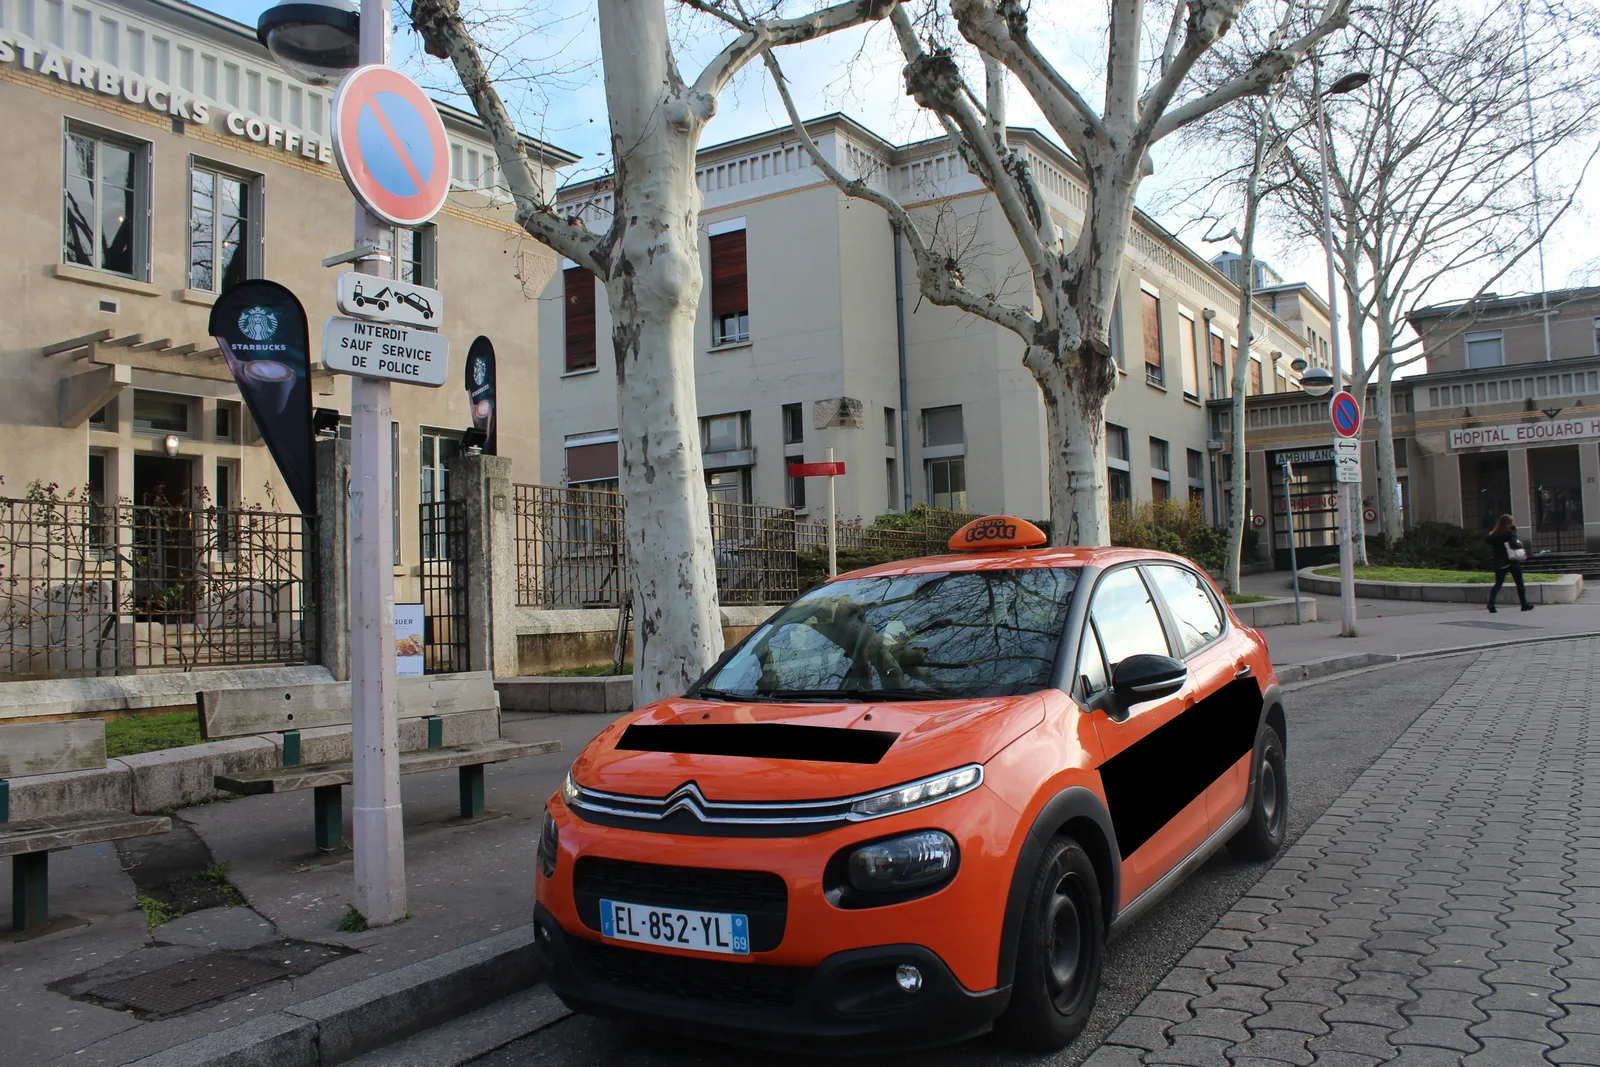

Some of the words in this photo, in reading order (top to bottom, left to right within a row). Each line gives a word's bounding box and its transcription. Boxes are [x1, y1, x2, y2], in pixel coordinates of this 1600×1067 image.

[0, 38, 210, 125] STARBUCKS
[226, 111, 332, 164] COFFEE
[354, 323, 408, 341] INTERDIT
[231, 343, 286, 351] STARBUCKS
[341, 337, 373, 352] SAUF
[382, 344, 432, 362] SERVICE
[352, 355, 367, 368] DE
[378, 360, 420, 376] POLICE
[1454, 429, 1510, 445] HOPITAL
[1517, 422, 1584, 439] EDOUARD
[966, 525, 1016, 542] ECOLE
[615, 906, 729, 947] EL-852-YL
[734, 937, 747, 950] 69
